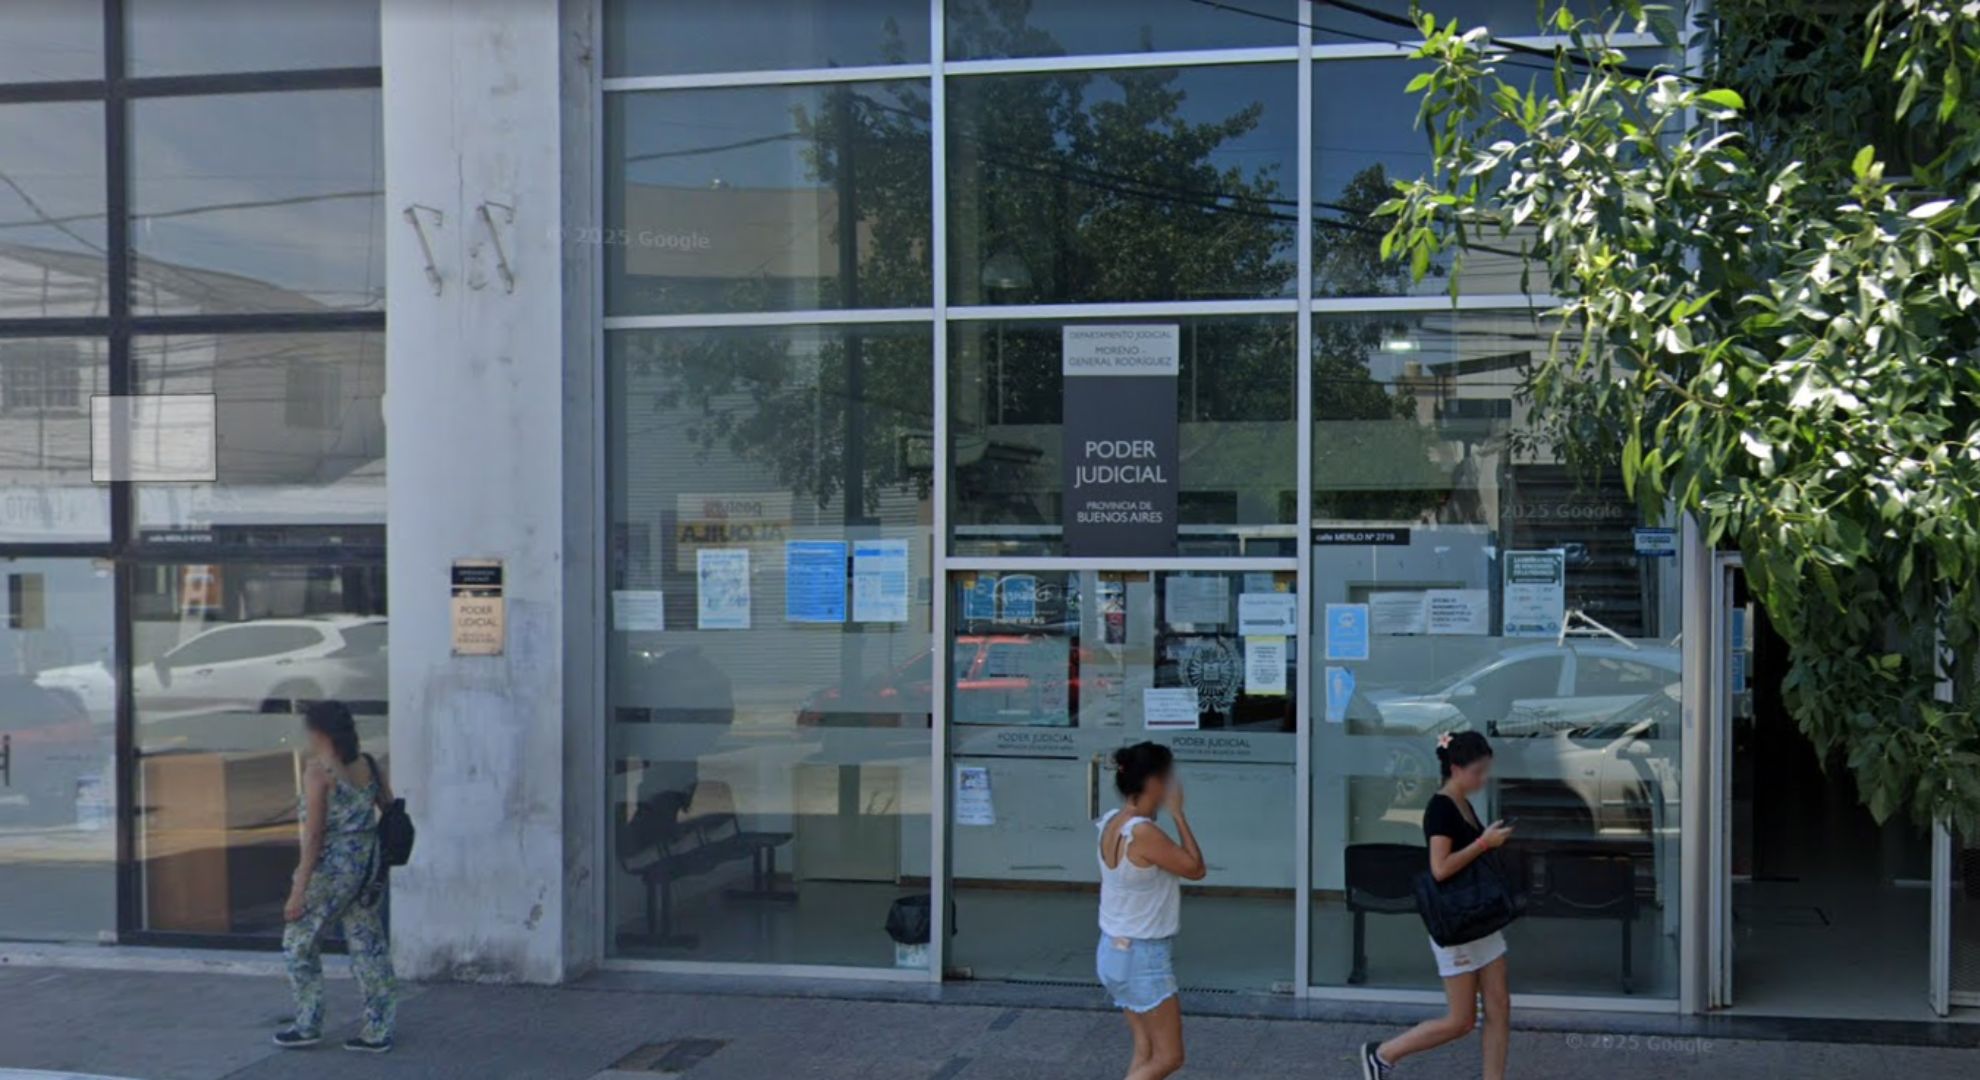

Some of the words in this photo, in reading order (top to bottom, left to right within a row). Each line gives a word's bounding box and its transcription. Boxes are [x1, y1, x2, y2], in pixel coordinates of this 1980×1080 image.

[1070, 330, 1134, 338] DEPARTAMENTO
[1134, 330, 1172, 341] JUDICIAL
[1095, 345, 1139, 355] MORENO
[1069, 356, 1112, 366] GENERAL
[1085, 440, 1156, 458] PODER
[1074, 465, 1167, 488] JUDICIAL
[1086, 501, 1137, 510] PROVINCIA
[1139, 501, 1152, 510] DE
[1077, 512, 1128, 523] BUENOS
[1129, 512, 1163, 523] AIRES
[1334, 532, 1364, 541] MERLO
[460, 605, 493, 615] PODER
[997, 732, 1031, 743] PODER
[1032, 733, 1074, 745] JUDICIAL
[1172, 736, 1205, 747] PODER
[1207, 737, 1251, 749] JUDICIAL
